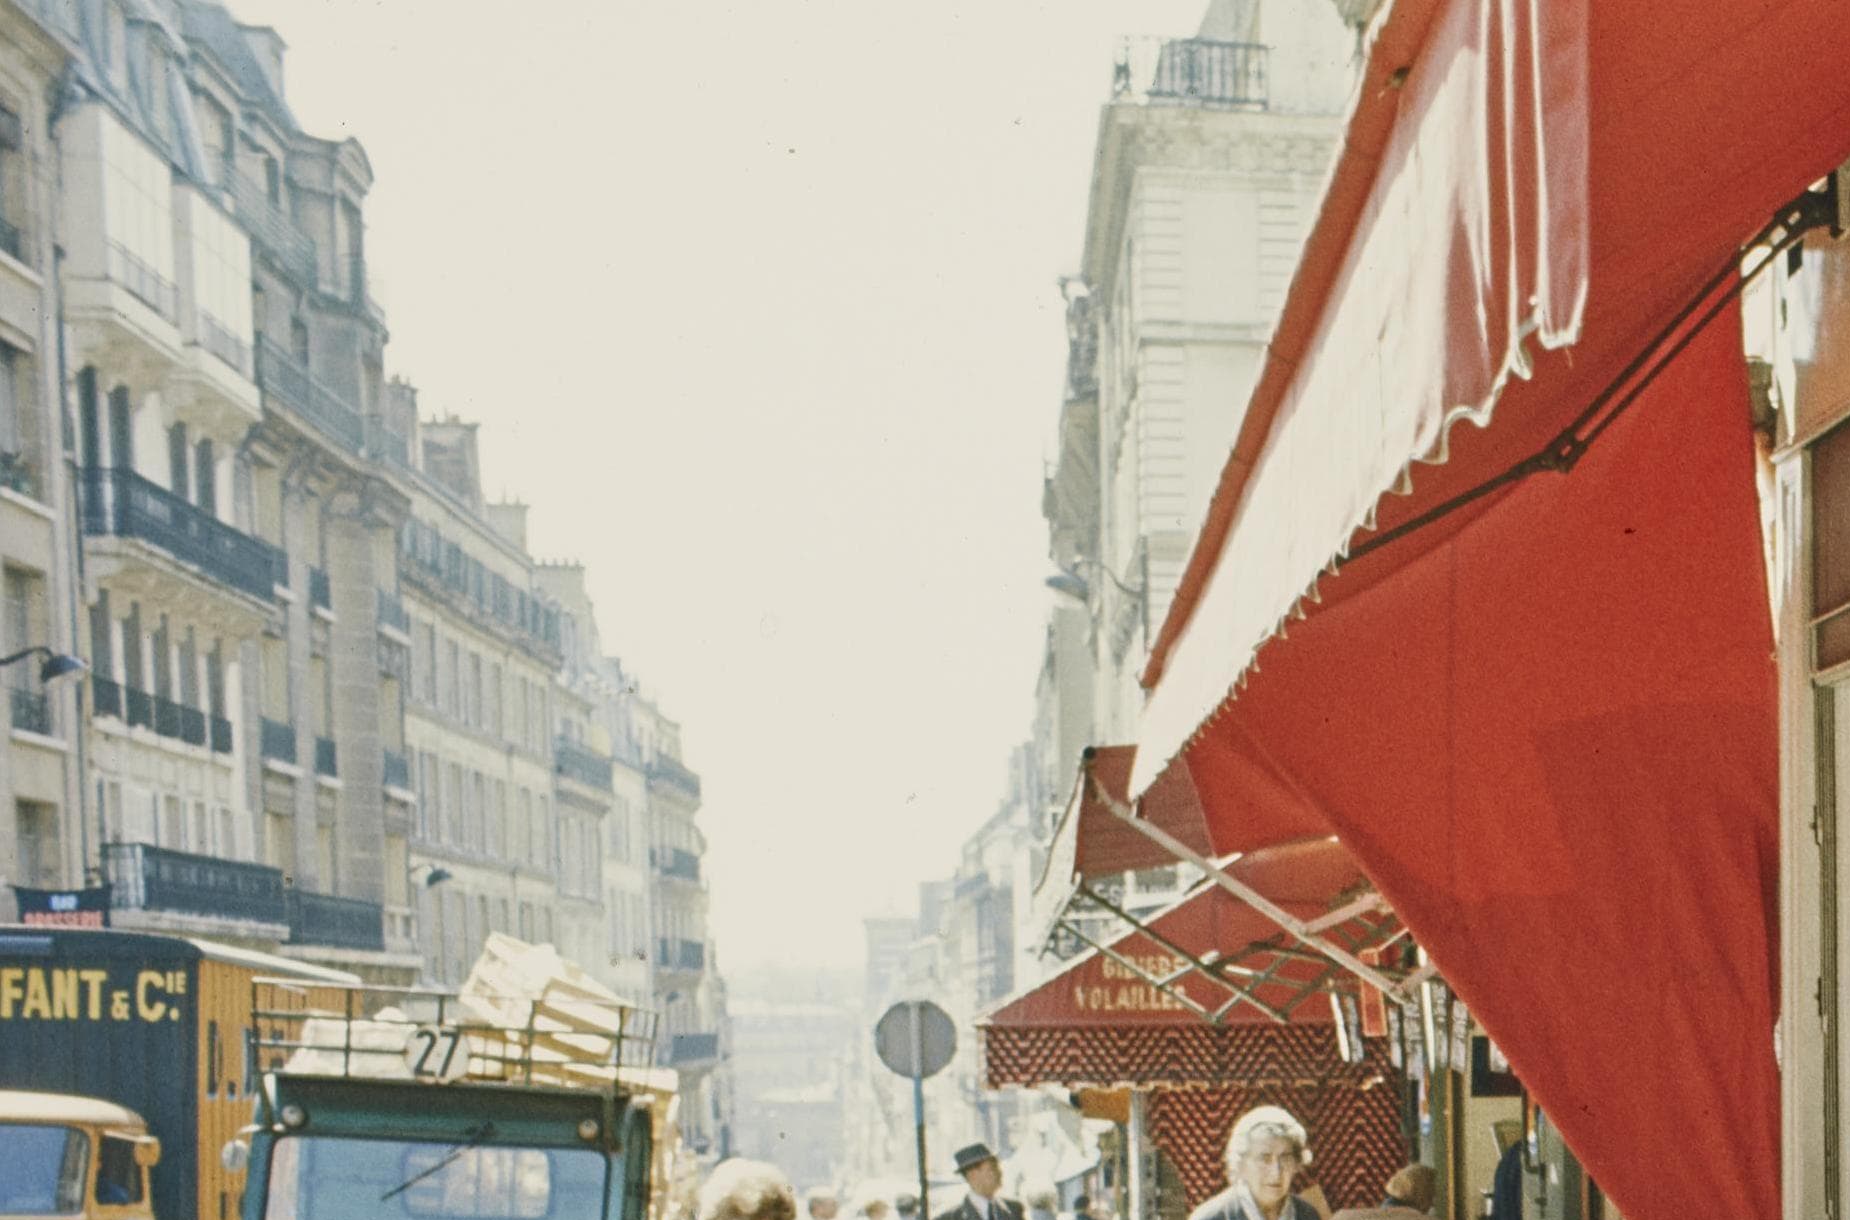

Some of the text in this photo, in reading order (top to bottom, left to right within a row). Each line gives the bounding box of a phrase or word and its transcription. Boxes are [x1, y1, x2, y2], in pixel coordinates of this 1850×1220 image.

[0, 967, 107, 1020] FANT
[111, 990, 130, 1021] &
[414, 1029, 459, 1078] 27
